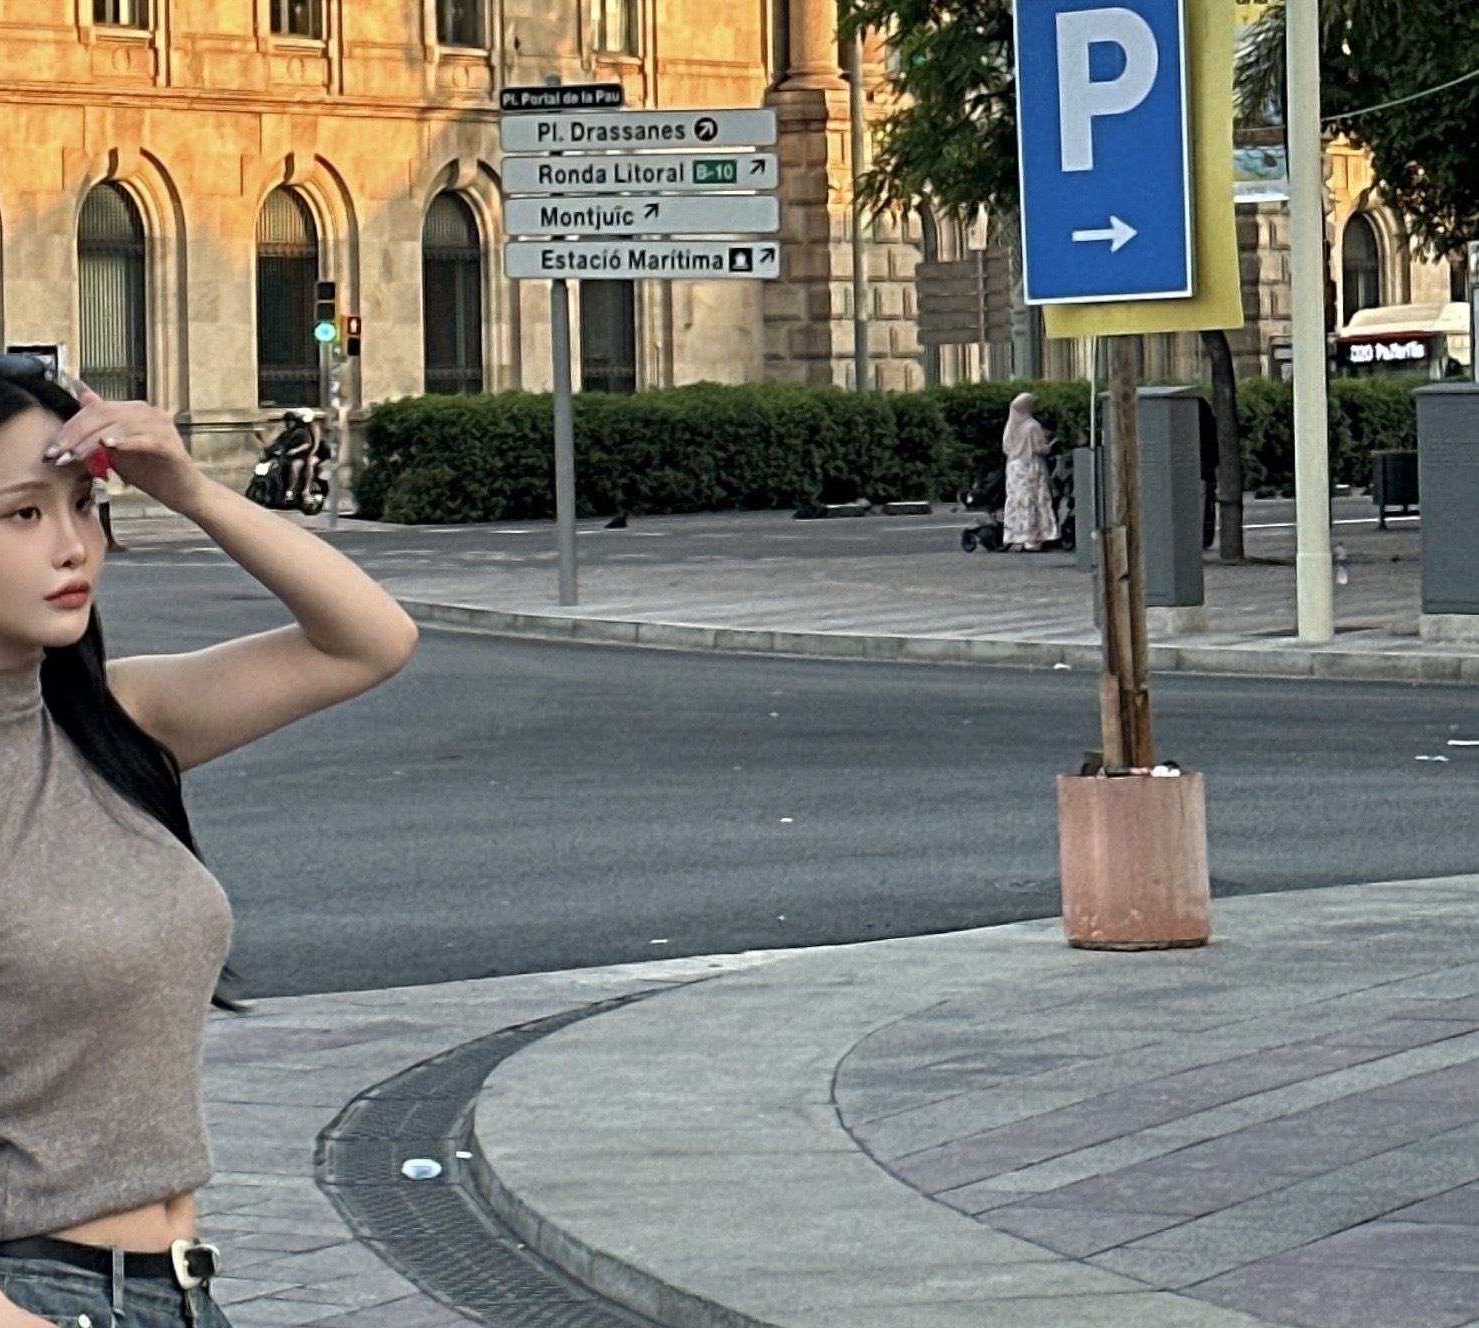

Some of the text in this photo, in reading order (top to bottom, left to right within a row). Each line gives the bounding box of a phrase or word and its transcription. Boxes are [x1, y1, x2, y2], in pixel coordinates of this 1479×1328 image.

[521, 91, 560, 107] Portal
[562, 91, 579, 105] de
[581, 90, 593, 104] la
[595, 89, 620, 104] Pau
[1055, 7, 1159, 172] P
[537, 121, 686, 142] Pl. Drassanes
[538, 162, 733, 185] Ronda Litoral B-10
[540, 204, 635, 231] Montjuïc
[541, 248, 724, 270] Estació Marítima
